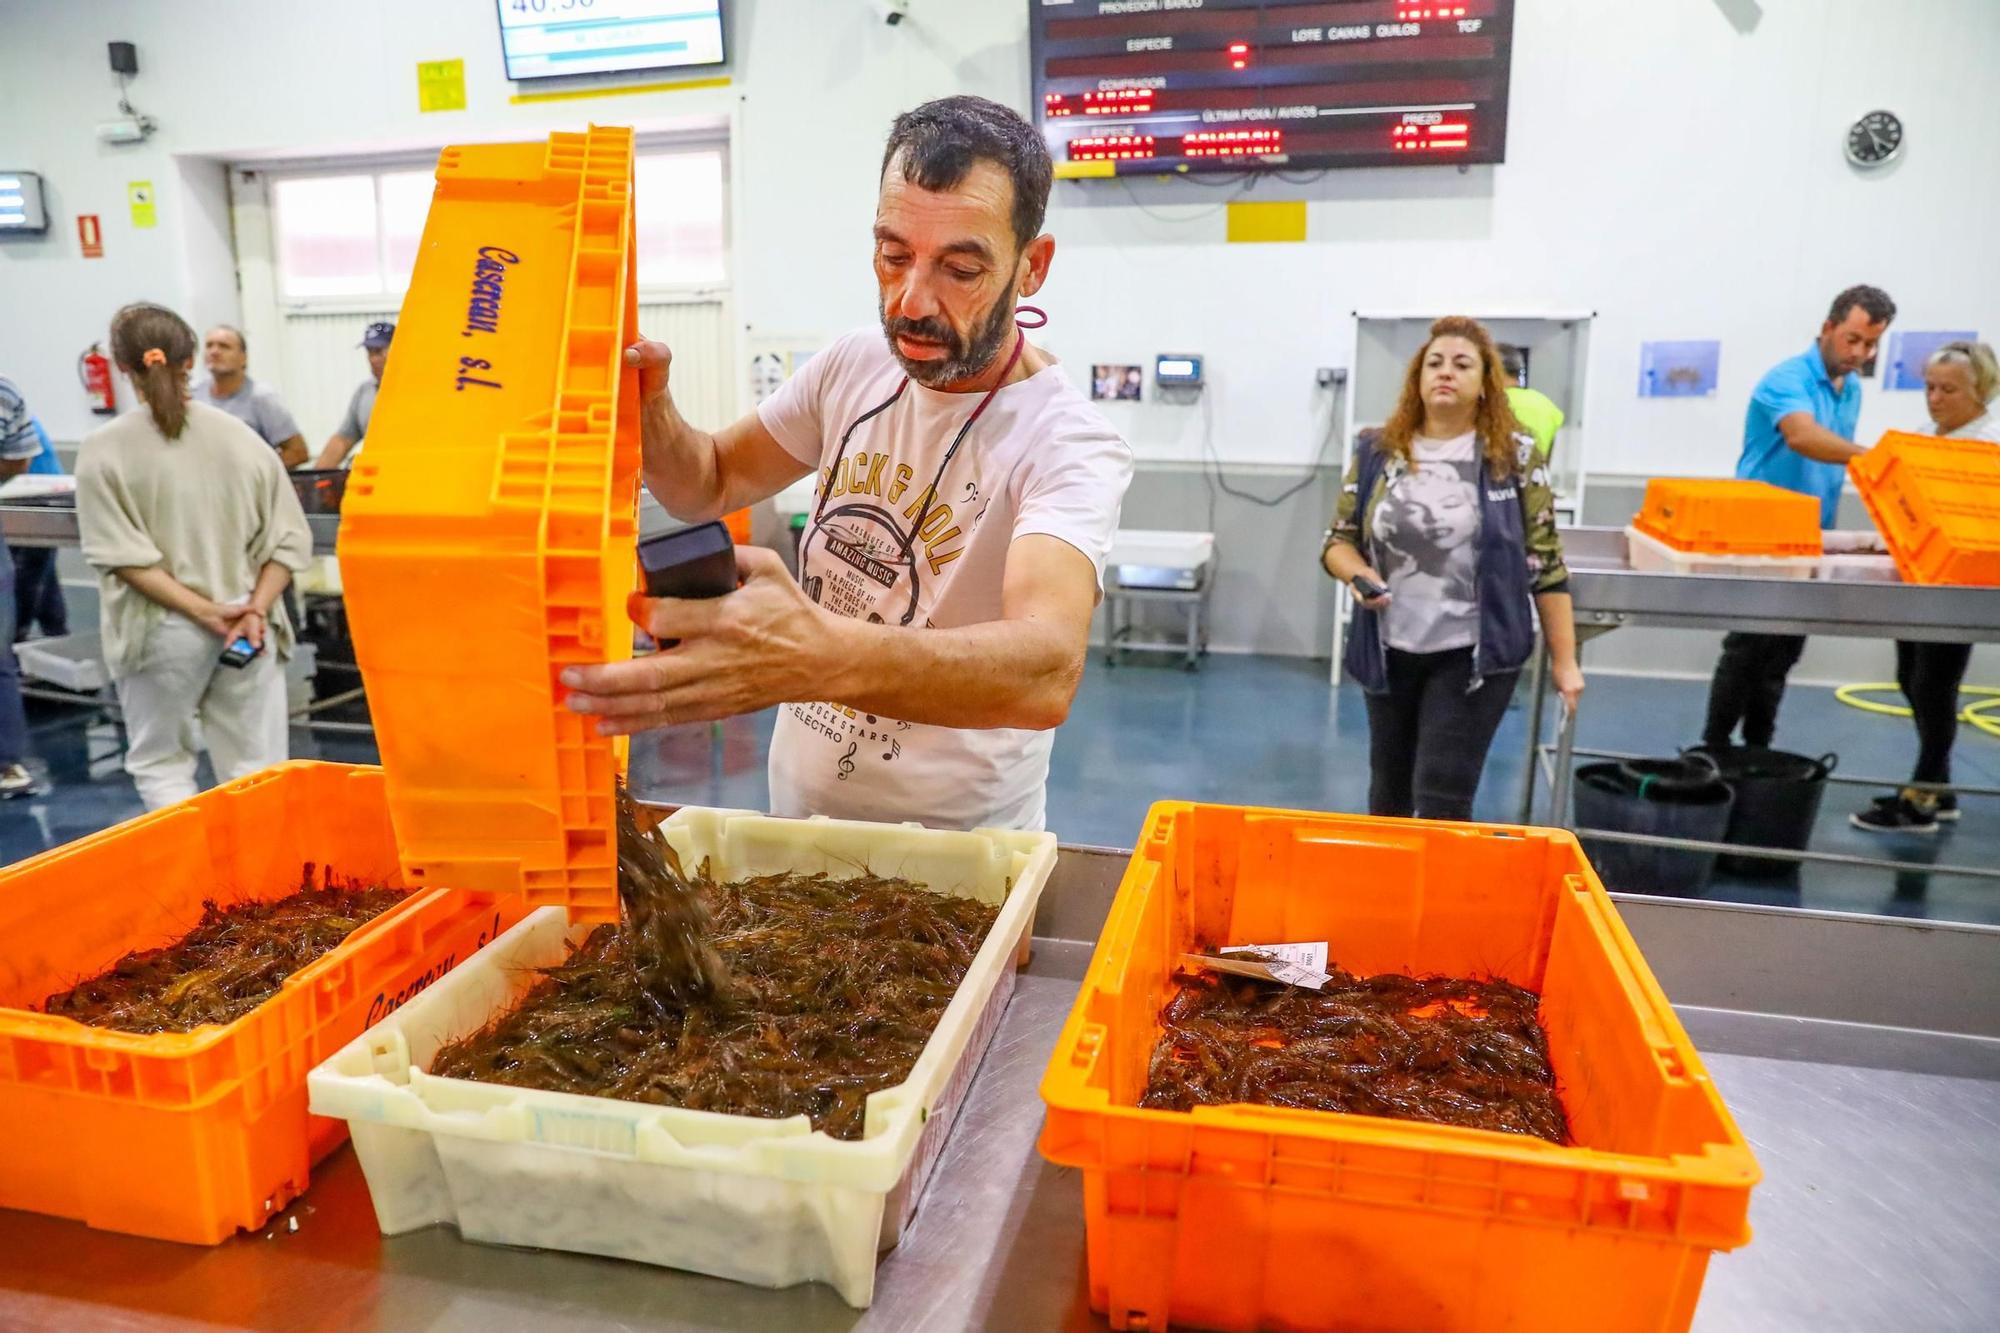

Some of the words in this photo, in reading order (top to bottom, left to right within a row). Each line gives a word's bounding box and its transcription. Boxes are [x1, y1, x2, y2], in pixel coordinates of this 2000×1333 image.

[1292, 28, 1322, 42] LOTE
[1376, 23, 1420, 37] QUILOS
[1127, 37, 1173, 51] ESPECIE
[850, 523, 884, 548] ABSOLUTE
[829, 540, 867, 568] AMAZING
[866, 562, 893, 584] MUSIC
[846, 570, 865, 586] MUSIC
[794, 707, 842, 744] ELECTRO
